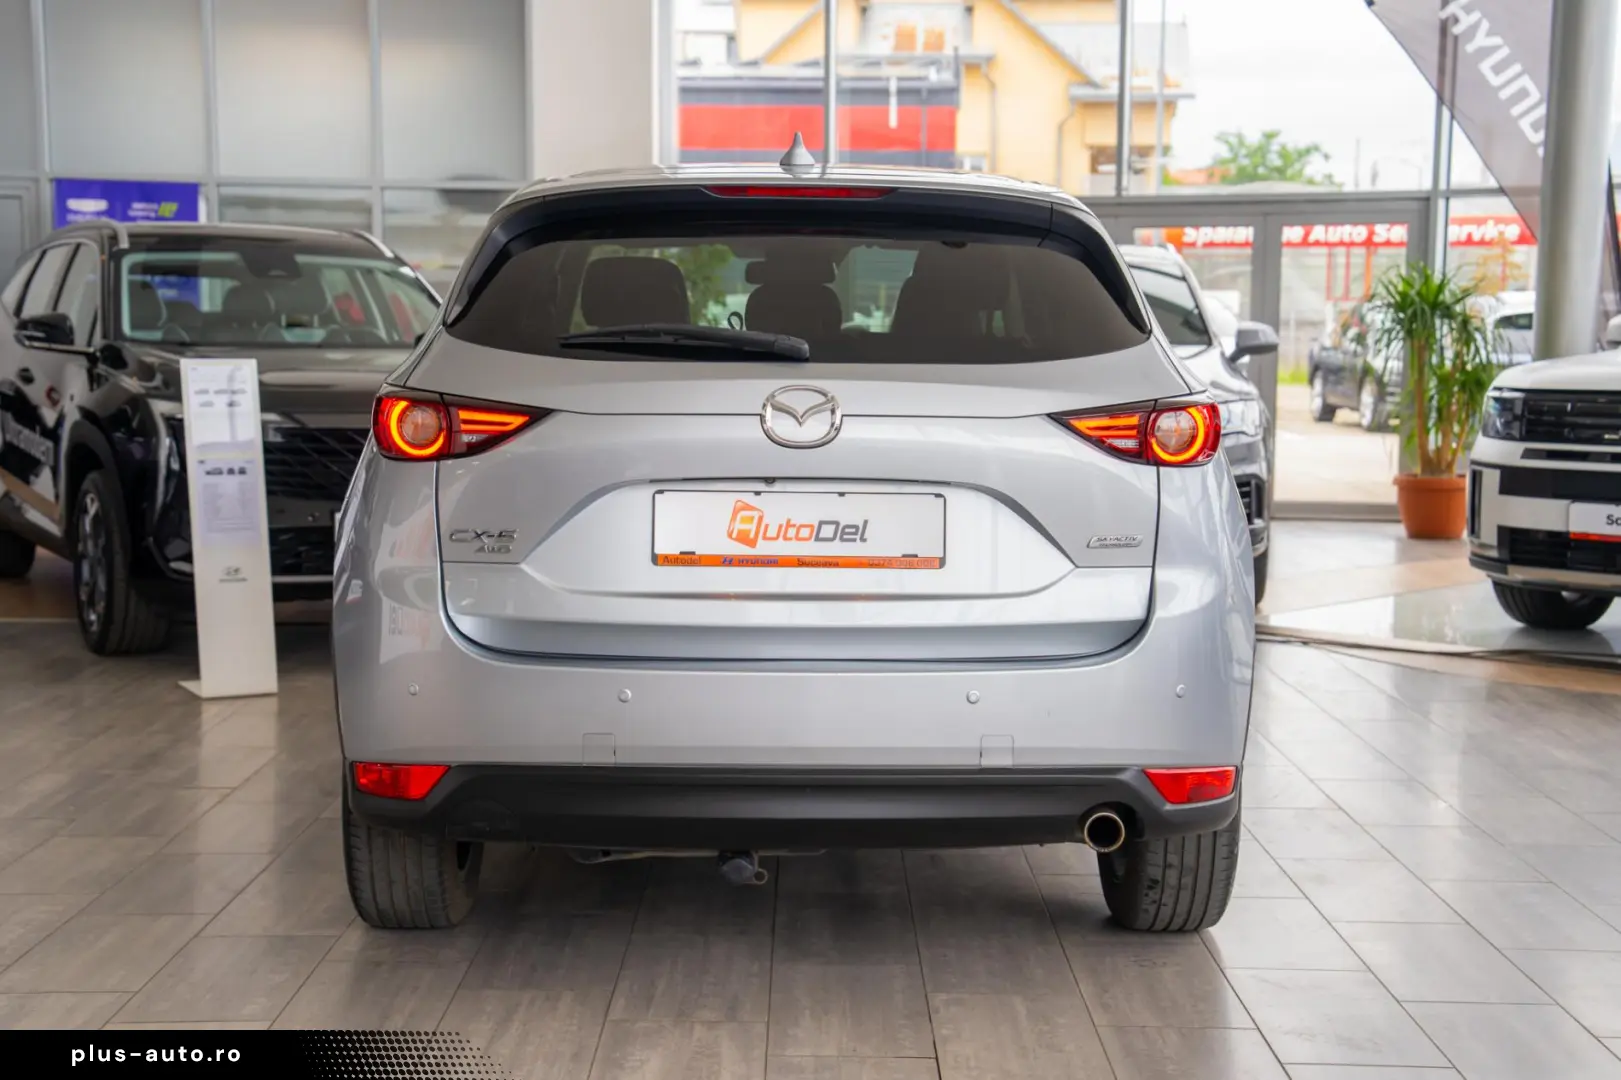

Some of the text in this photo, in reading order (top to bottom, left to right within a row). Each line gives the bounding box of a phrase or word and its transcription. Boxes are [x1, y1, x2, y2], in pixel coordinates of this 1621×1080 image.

[1438, 0, 1547, 158] HYUND
[1307, 223, 1368, 244] Auto
[1447, 218, 1521, 242] ervice
[449, 527, 519, 543] CX-5
[728, 503, 868, 546] AutoDel
